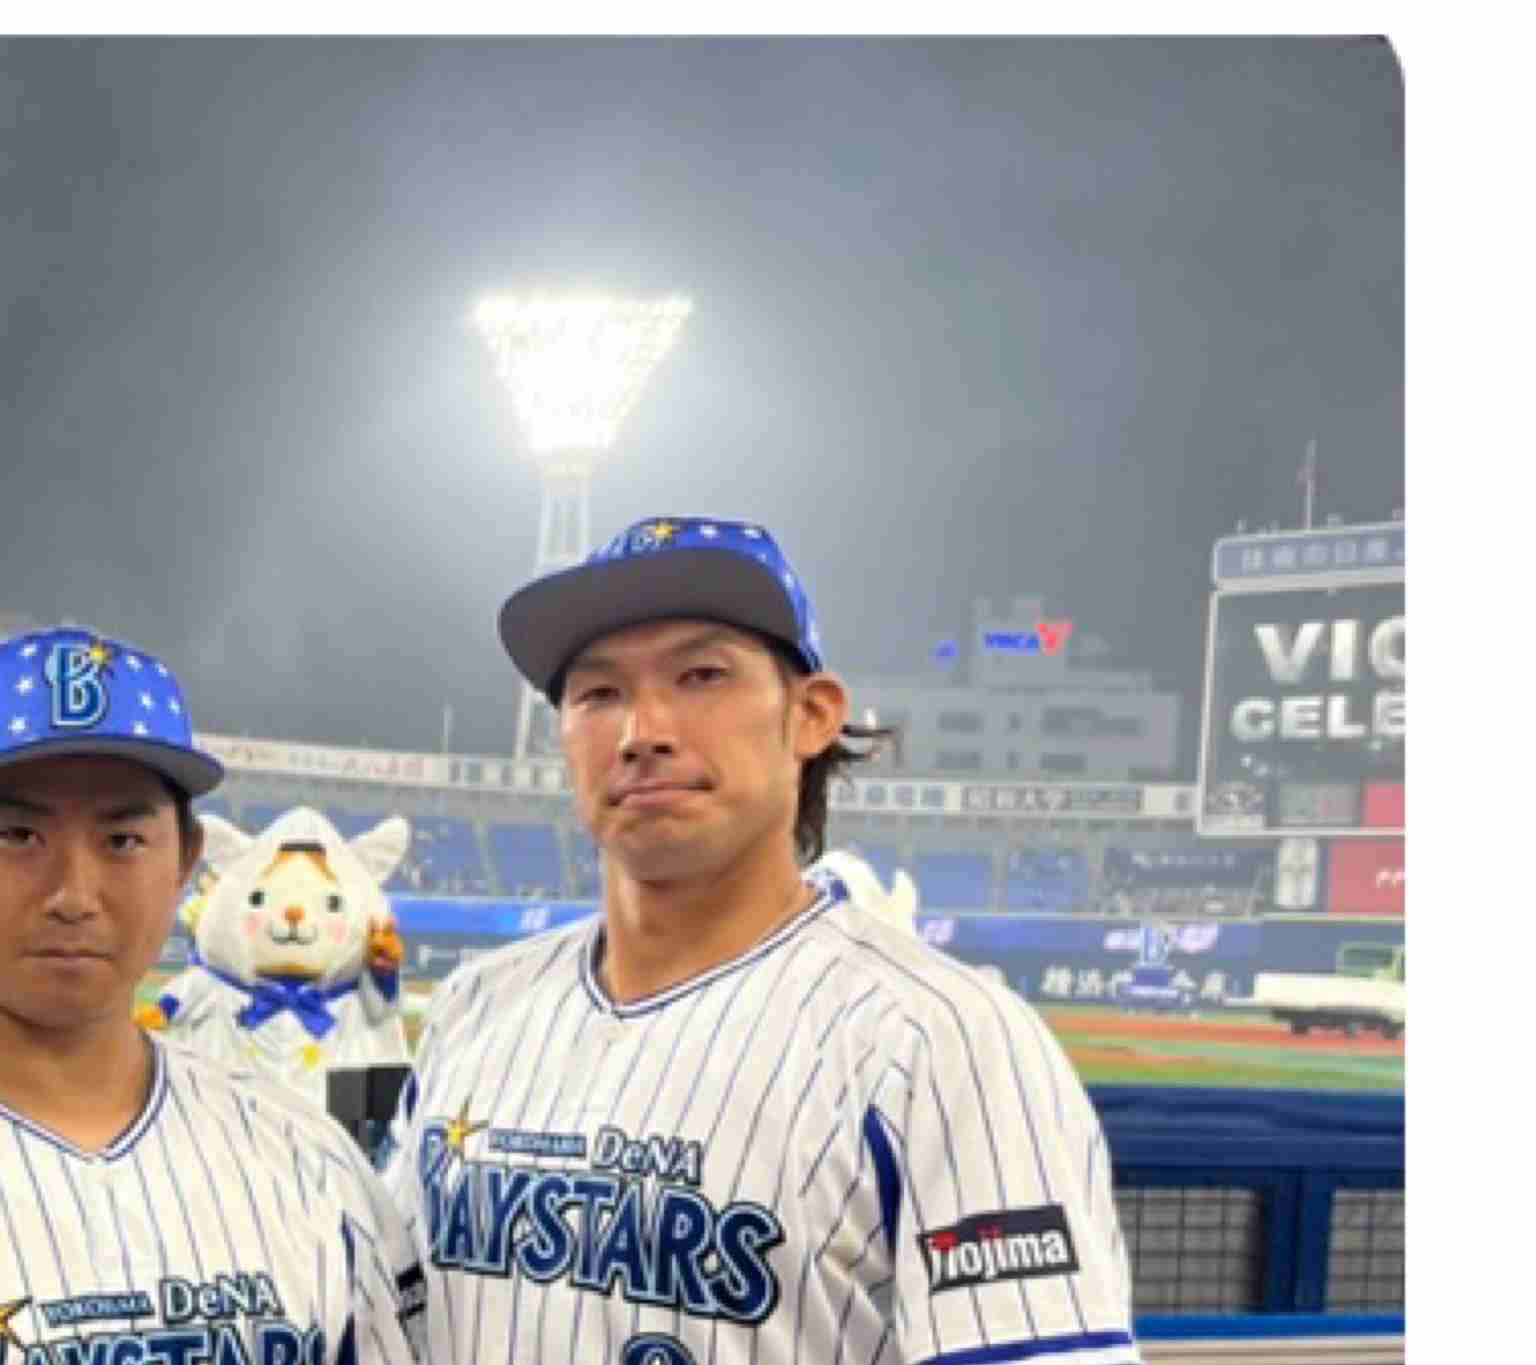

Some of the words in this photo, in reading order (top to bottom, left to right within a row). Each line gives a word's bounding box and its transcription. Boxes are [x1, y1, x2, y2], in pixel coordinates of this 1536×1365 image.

[42, 640, 111, 731] B
[591, 1125, 704, 1187] DeNA
[160, 1270, 286, 1324] DeNA
